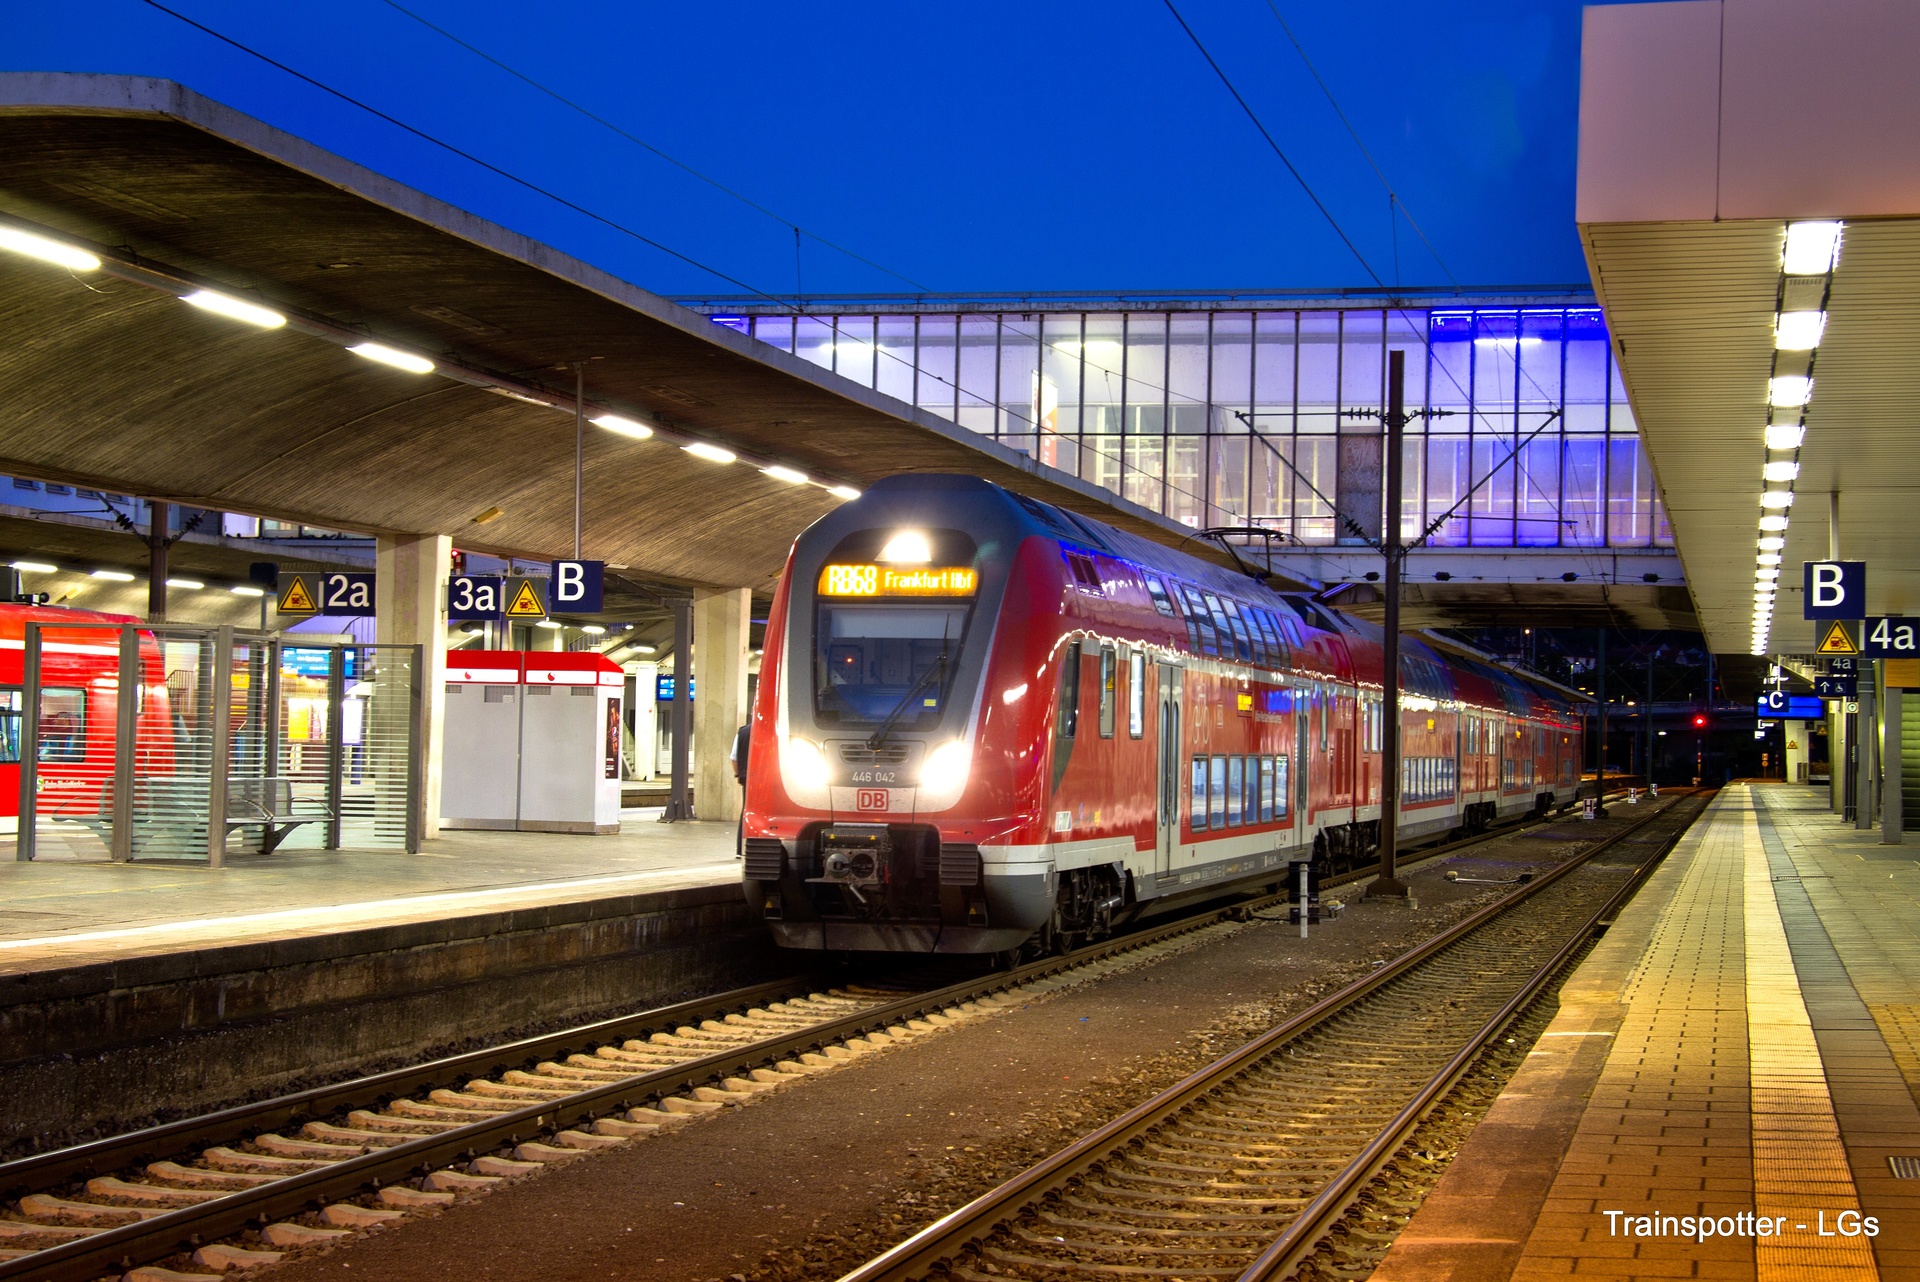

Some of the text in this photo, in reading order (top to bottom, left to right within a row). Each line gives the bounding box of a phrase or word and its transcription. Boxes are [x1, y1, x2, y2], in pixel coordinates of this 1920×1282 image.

[328, 574, 370, 608] 2a
[453, 577, 496, 611] 3a
[558, 562, 585, 601] B
[828, 565, 972, 594] RB68 Frankfurt Hbf
[1812, 564, 1845, 607] B
[1870, 618, 1916, 650] 4a
[1832, 658, 1852, 670] 4a
[1769, 691, 1784, 709] C
[852, 771, 895, 783] 446 042
[860, 791, 886, 809] DB
[1584, 799, 1593, 812] H
